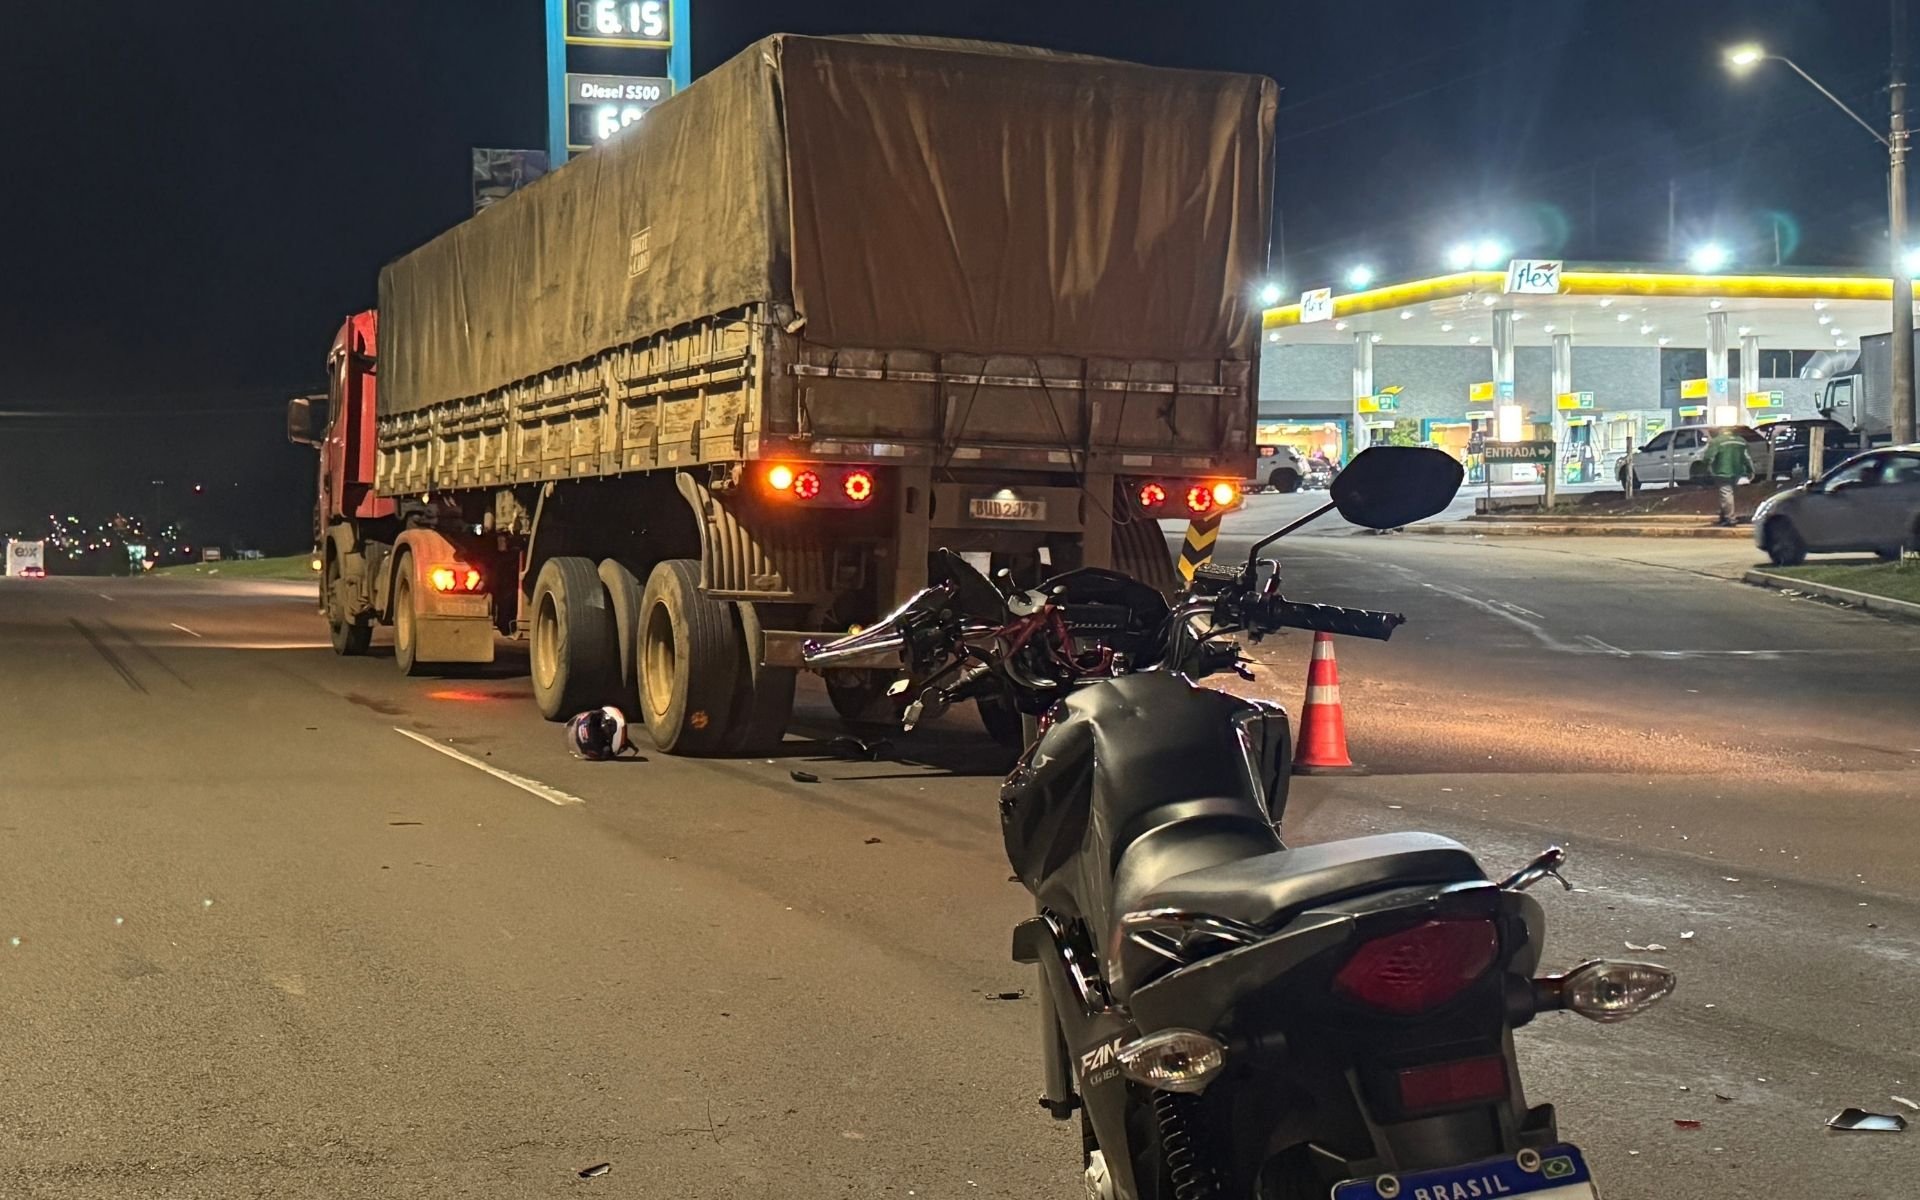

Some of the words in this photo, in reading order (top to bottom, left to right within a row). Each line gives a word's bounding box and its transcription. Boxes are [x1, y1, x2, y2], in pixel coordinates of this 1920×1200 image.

[596, 0, 662, 35] 6.15
[581, 83, 624, 98] Diesel
[625, 85, 660, 100] S500
[1517, 262, 1554, 290] flex
[1485, 447, 1537, 458] ENTRADA
[1081, 1037, 1122, 1077] FAN
[1415, 1174, 1510, 1200] BRASIL
